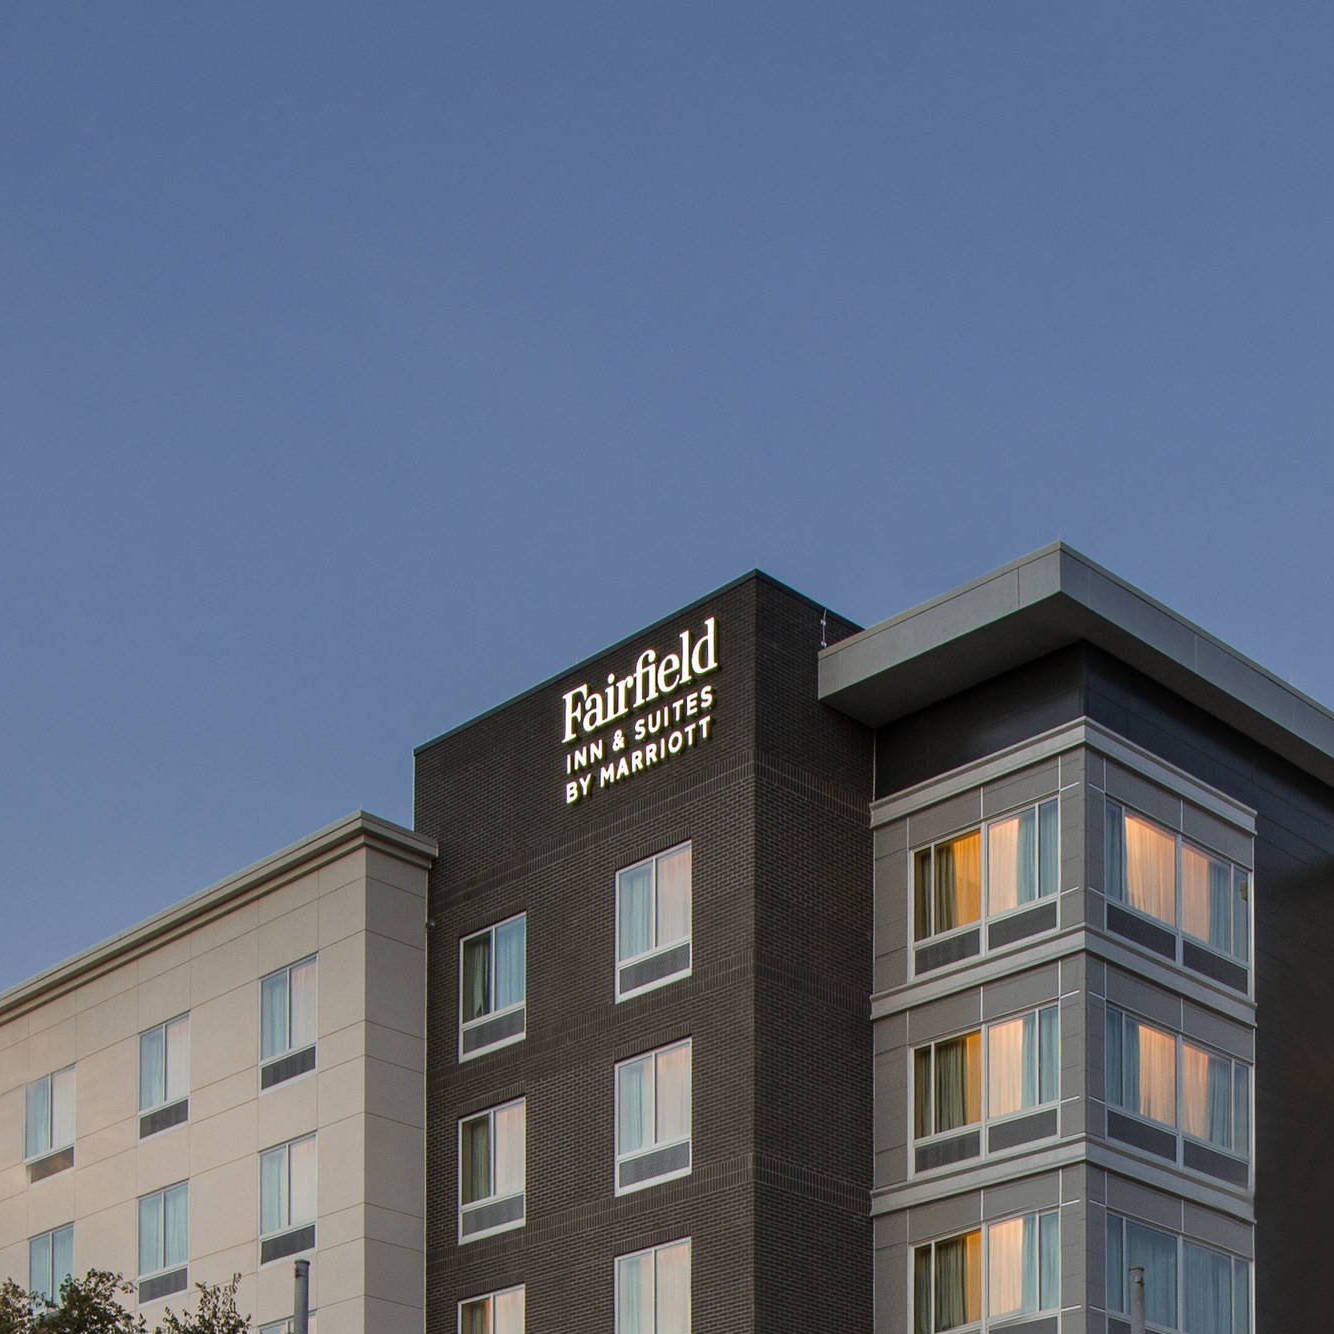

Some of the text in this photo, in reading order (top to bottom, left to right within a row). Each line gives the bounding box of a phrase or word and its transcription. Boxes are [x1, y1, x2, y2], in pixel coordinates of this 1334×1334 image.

[562, 616, 718, 743] Fairfield
[566, 685, 713, 774] INN & SUITES
[566, 715, 711, 804] BY MARRIOTT
